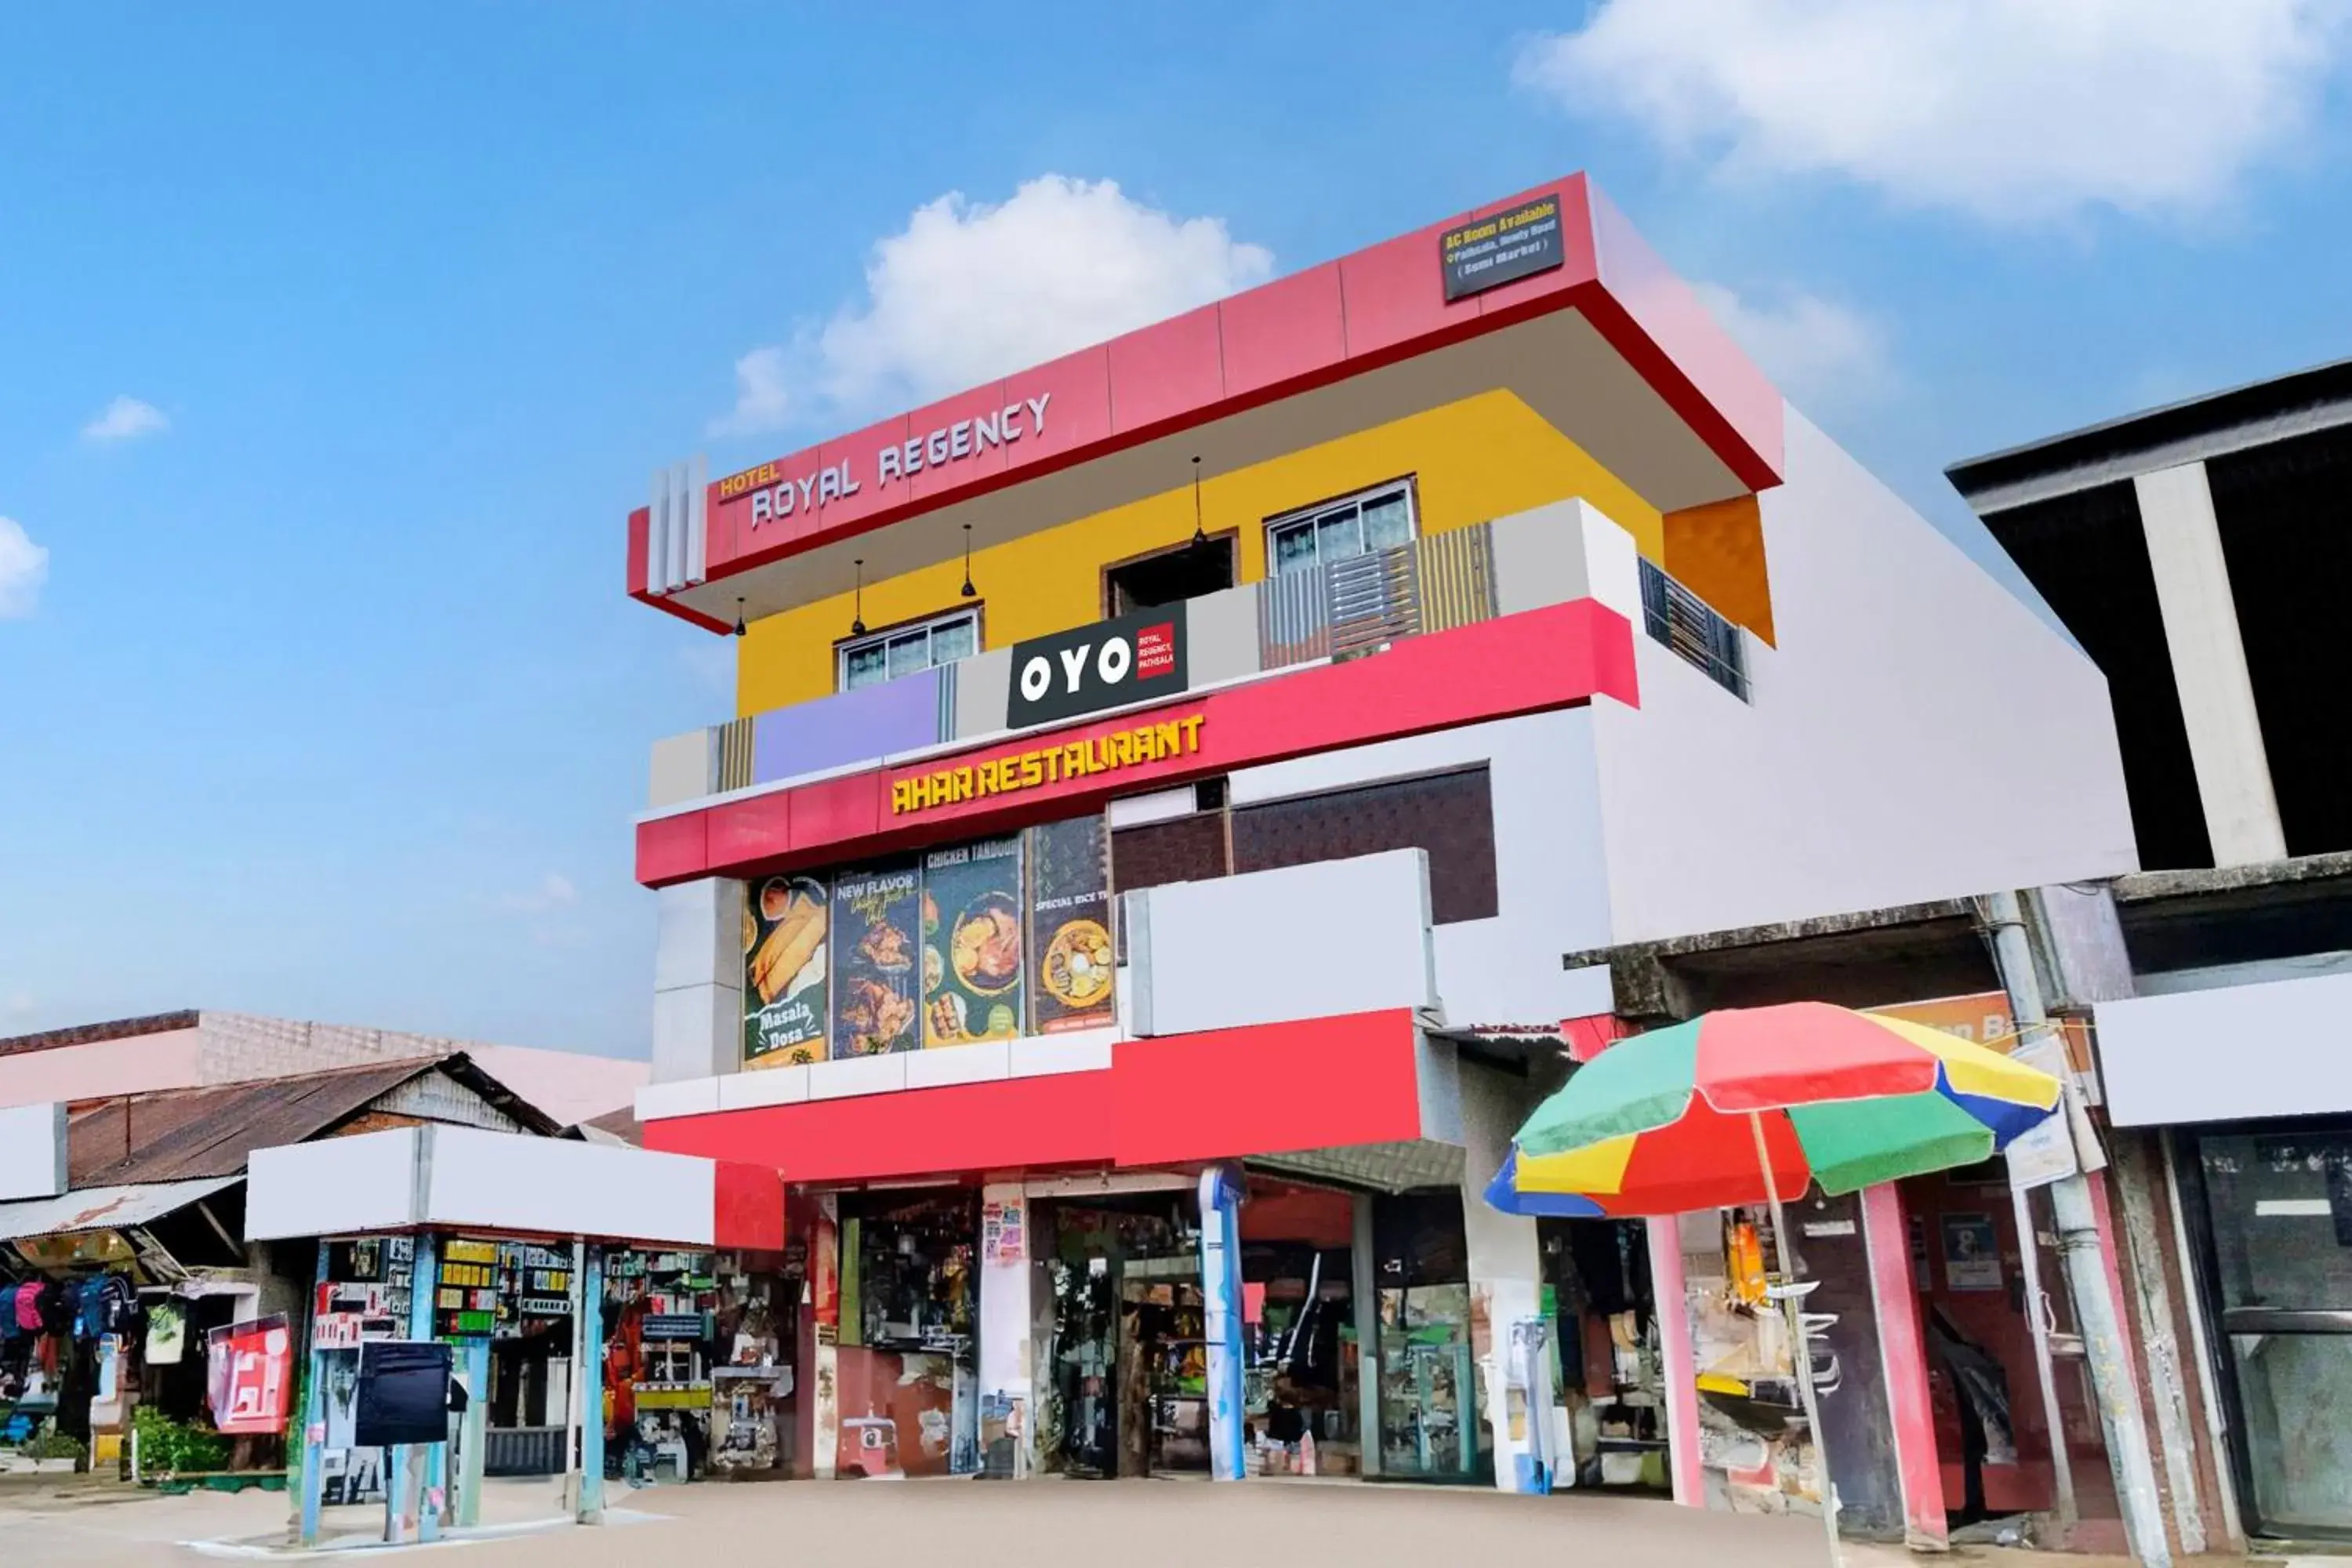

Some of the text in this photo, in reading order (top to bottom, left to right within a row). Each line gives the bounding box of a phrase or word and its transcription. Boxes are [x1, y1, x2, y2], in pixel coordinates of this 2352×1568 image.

[751, 393, 1050, 528] ROYAL REGENCY
[720, 463, 780, 496] HOTEL
[1021, 637, 1131, 702] OYO
[893, 713, 1205, 815] AHAR RESTAURANT
[837, 883, 865, 900] NEW
[866, 875, 914, 897] FLAVOR
[760, 1002, 810, 1031] Masala
[769, 1028, 804, 1050] Dosa
